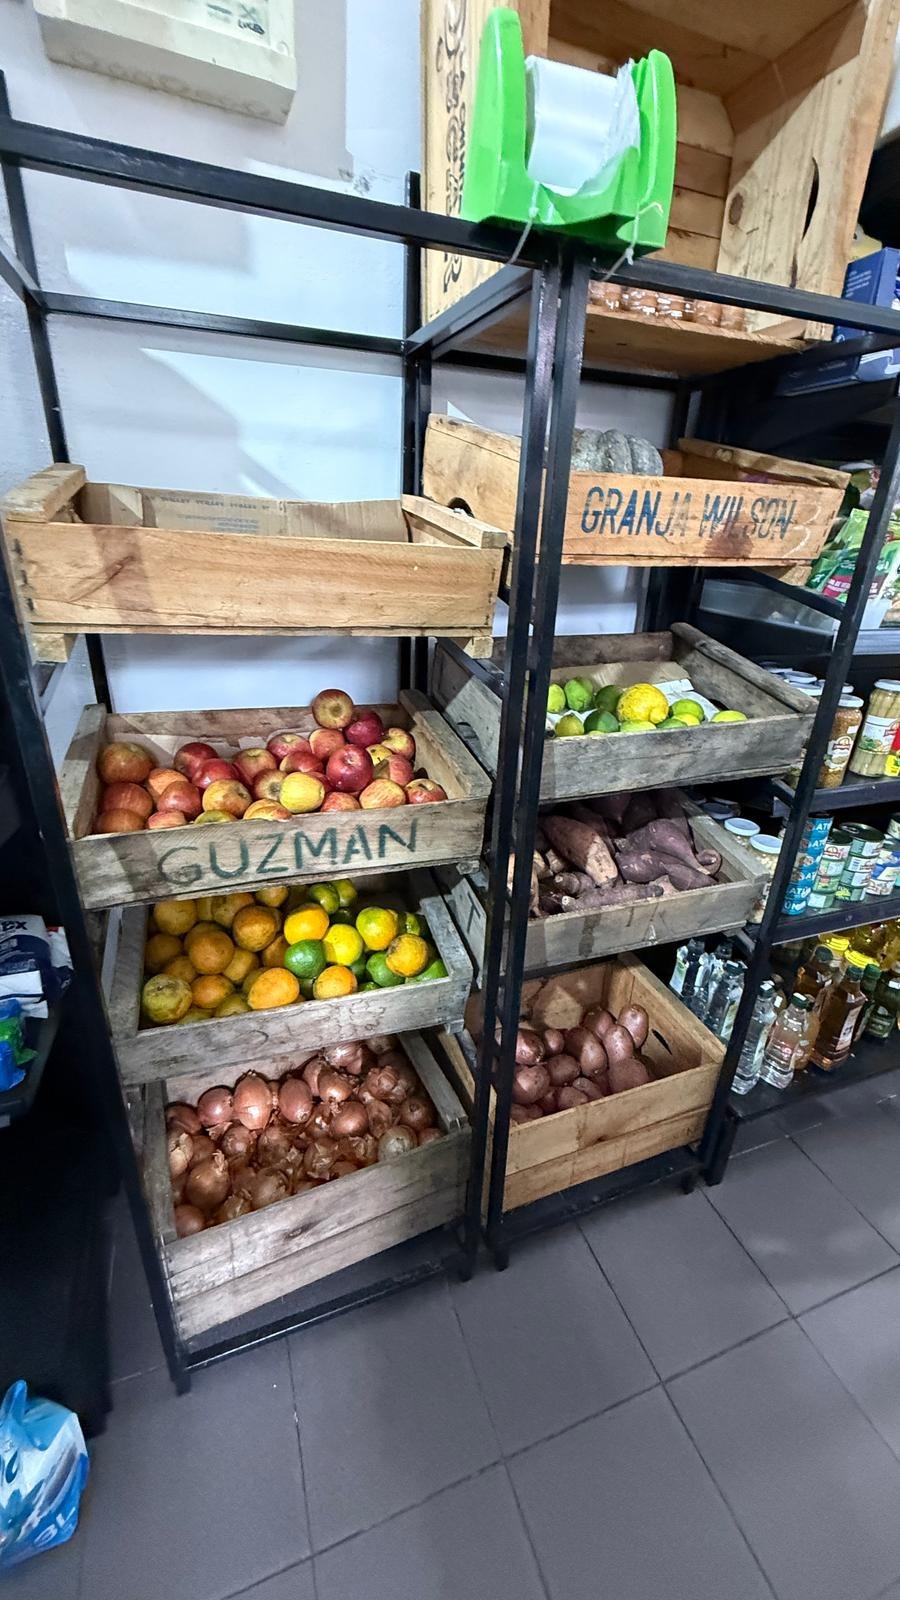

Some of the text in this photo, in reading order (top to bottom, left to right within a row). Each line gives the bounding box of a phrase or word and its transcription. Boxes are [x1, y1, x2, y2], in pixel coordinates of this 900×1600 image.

[581, 486, 797, 540] GRANJA WILSON
[157, 818, 420, 885] GUZMAN
